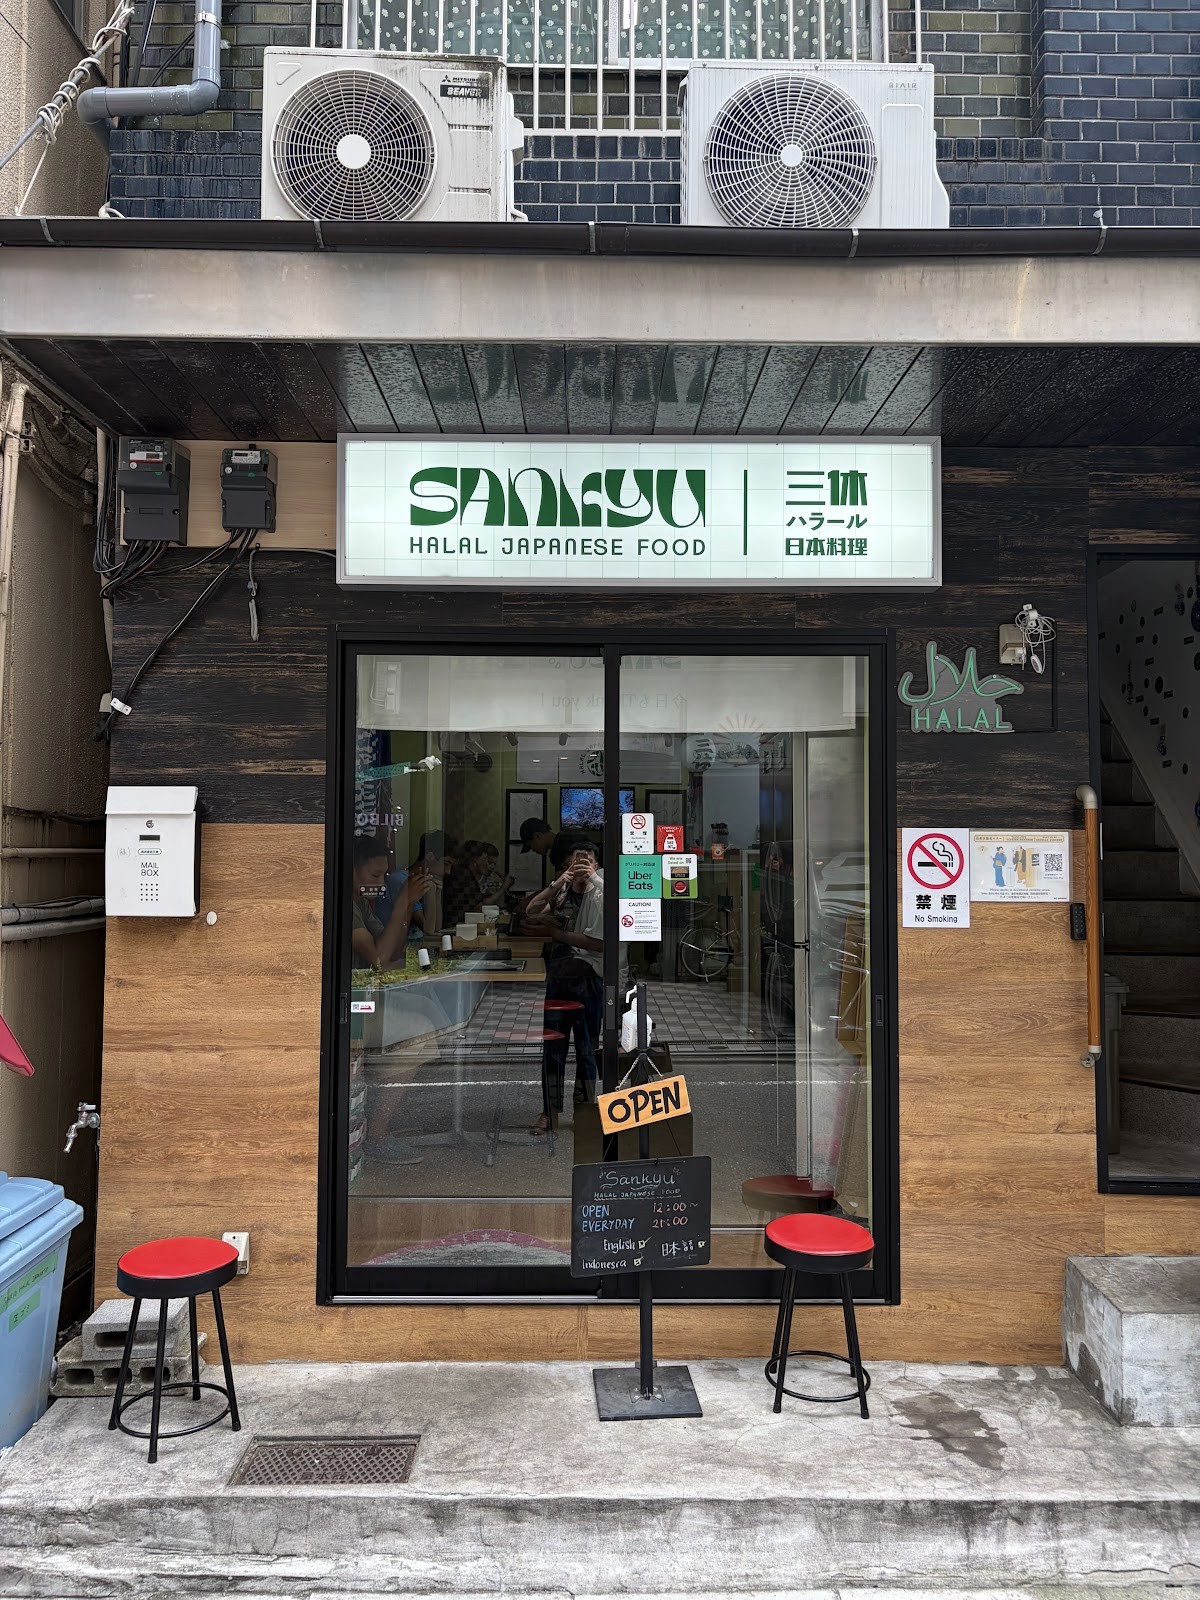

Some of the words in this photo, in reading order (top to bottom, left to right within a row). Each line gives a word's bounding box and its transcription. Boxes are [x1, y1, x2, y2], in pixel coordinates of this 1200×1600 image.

[446, 86, 482, 97] BEAVER
[410, 466, 706, 528] SANKYU
[786, 470, 868, 506] 三休
[786, 512, 868, 531] ハラール
[410, 536, 488, 554] HALAL
[502, 537, 623, 556] JAPANESE
[638, 538, 706, 556] FOOD
[786, 538, 868, 556] 日本料理
[900, 644, 1022, 706] حلال
[914, 708, 1009, 729] HALAL
[628, 871, 653, 880] Uber
[628, 881, 653, 890] Eats
[916, 894, 957, 910] 禁煙
[927, 915, 958, 924] Smoking
[606, 1084, 682, 1124] OPEN
[604, 1170, 676, 1188] Sankyu
[582, 1204, 610, 1218] OPEN
[653, 1202, 687, 1213] 12:00
[582, 1218, 635, 1232] EVERYDAY
[652, 1216, 688, 1228] 21:00
[603, 1239, 636, 1254] English
